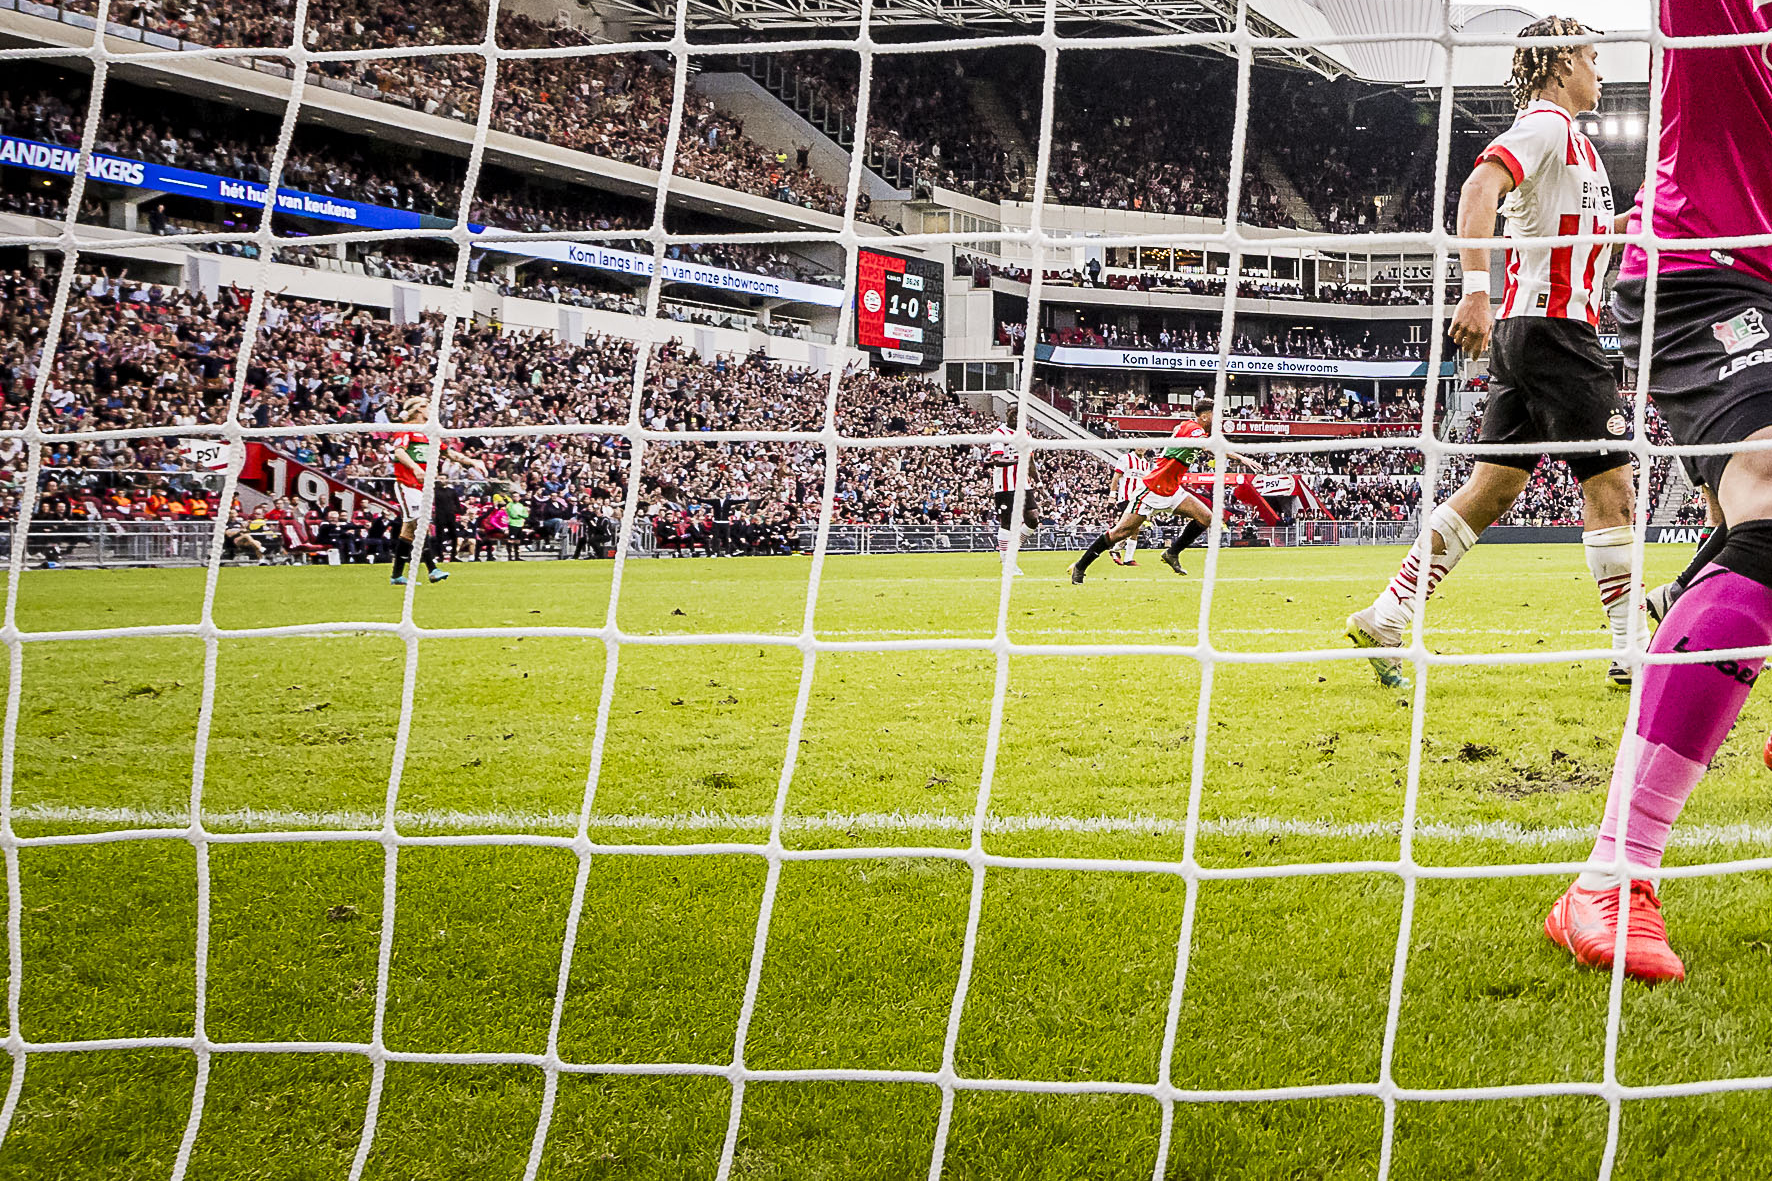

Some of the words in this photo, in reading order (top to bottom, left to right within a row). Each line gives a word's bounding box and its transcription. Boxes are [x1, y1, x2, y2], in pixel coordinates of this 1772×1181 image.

[0, 138, 145, 186] ANDEMAKERS
[220, 180, 245, 199] hét
[247, 185, 276, 206] hui
[278, 194, 303, 211] van
[304, 196, 357, 220] keukens
[568, 245, 596, 265] Kom
[600, 250, 631, 273] langs
[634, 257, 644, 272] in
[648, 261, 669, 277] en
[672, 267, 691, 281] van
[694, 271, 720, 285] onze
[722, 273, 780, 296] showrooms
[889, 294, 919, 318] 1-0
[1122, 353, 1148, 365] Kom
[1152, 354, 1183, 368] langs
[1186, 355, 1196, 367] in
[1247, 360, 1273, 371] onze
[1277, 360, 1338, 373] showrooms
[1236, 422, 1247, 432] de
[1250, 422, 1290, 435] verlenging
[196, 447, 220, 462] PSV
[1265, 480, 1280, 489] PSV
